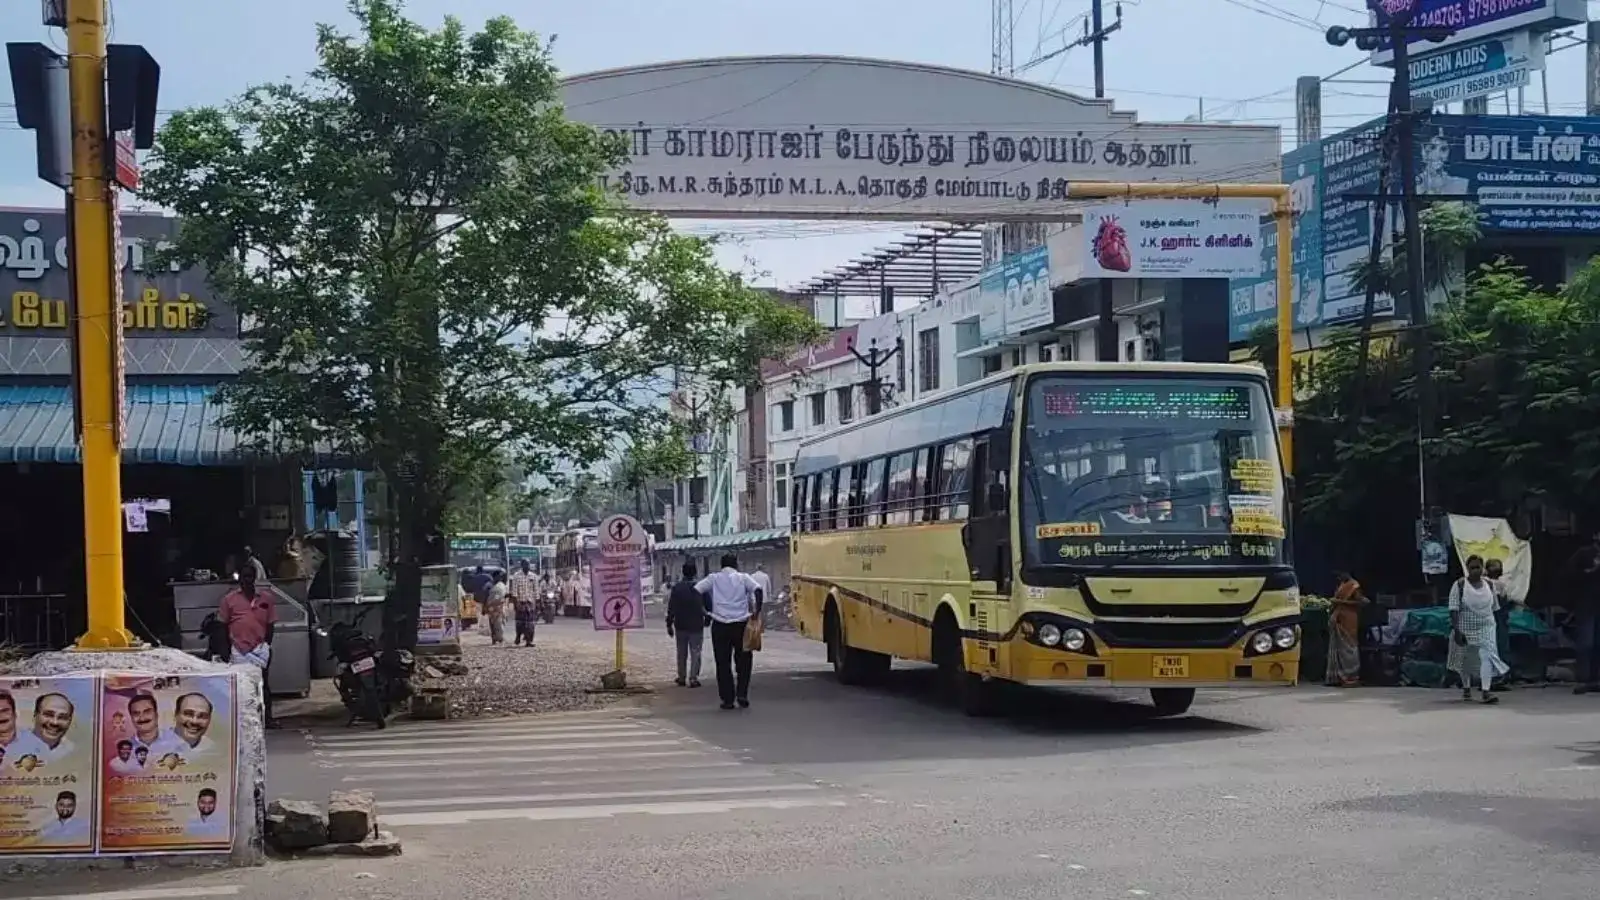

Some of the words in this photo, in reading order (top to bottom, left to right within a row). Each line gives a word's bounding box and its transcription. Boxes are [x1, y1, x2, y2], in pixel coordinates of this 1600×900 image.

[1455, 44, 1488, 70] ADDS
[664, 124, 823, 163] காமராஜர்
[836, 127, 955, 167] பேருந்து
[964, 130, 1097, 168] நிலையம்,
[1464, 125, 1584, 162] மாடர்ன்
[935, 176, 1030, 201] மேம்பாட்டு
[601, 543, 613, 552] NO
[616, 543, 641, 552] ENTRY
[1058, 543, 1092, 559] அரசு
[1241, 541, 1277, 558] சேலம்
